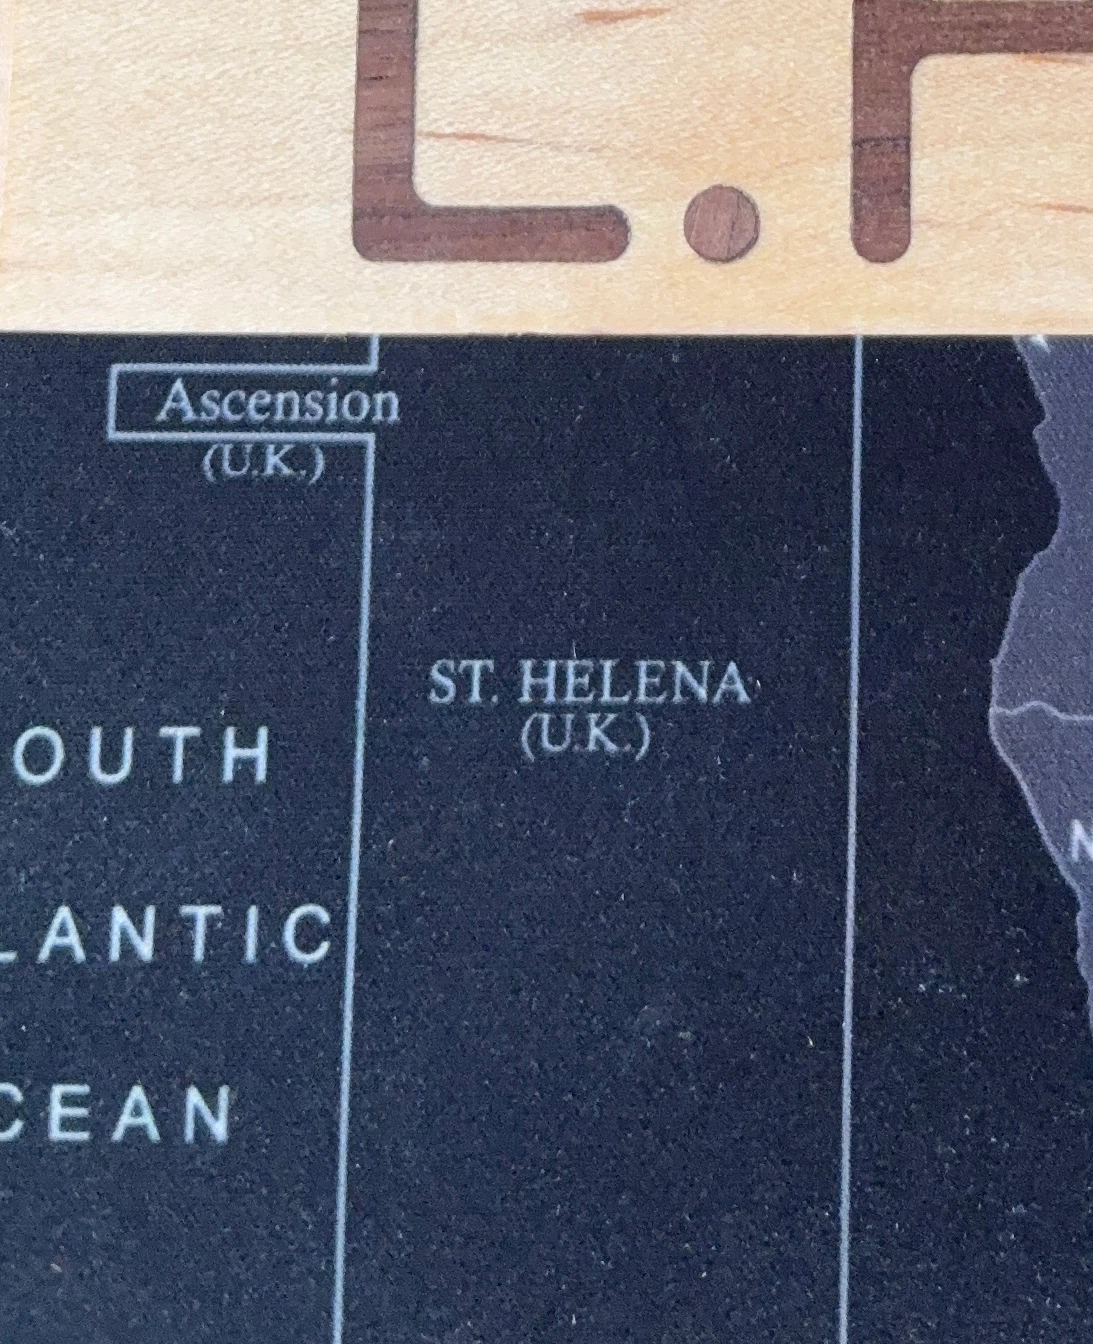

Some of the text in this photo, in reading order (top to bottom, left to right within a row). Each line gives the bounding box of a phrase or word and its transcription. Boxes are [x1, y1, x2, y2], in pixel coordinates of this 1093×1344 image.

[155, 378, 401, 424] Ascension
[203, 443, 325, 483] (U.K.)
[429, 659, 751, 705] ST. HELENA
[12, 725, 270, 785] OUTH
[520, 712, 652, 762] (U.K.)
